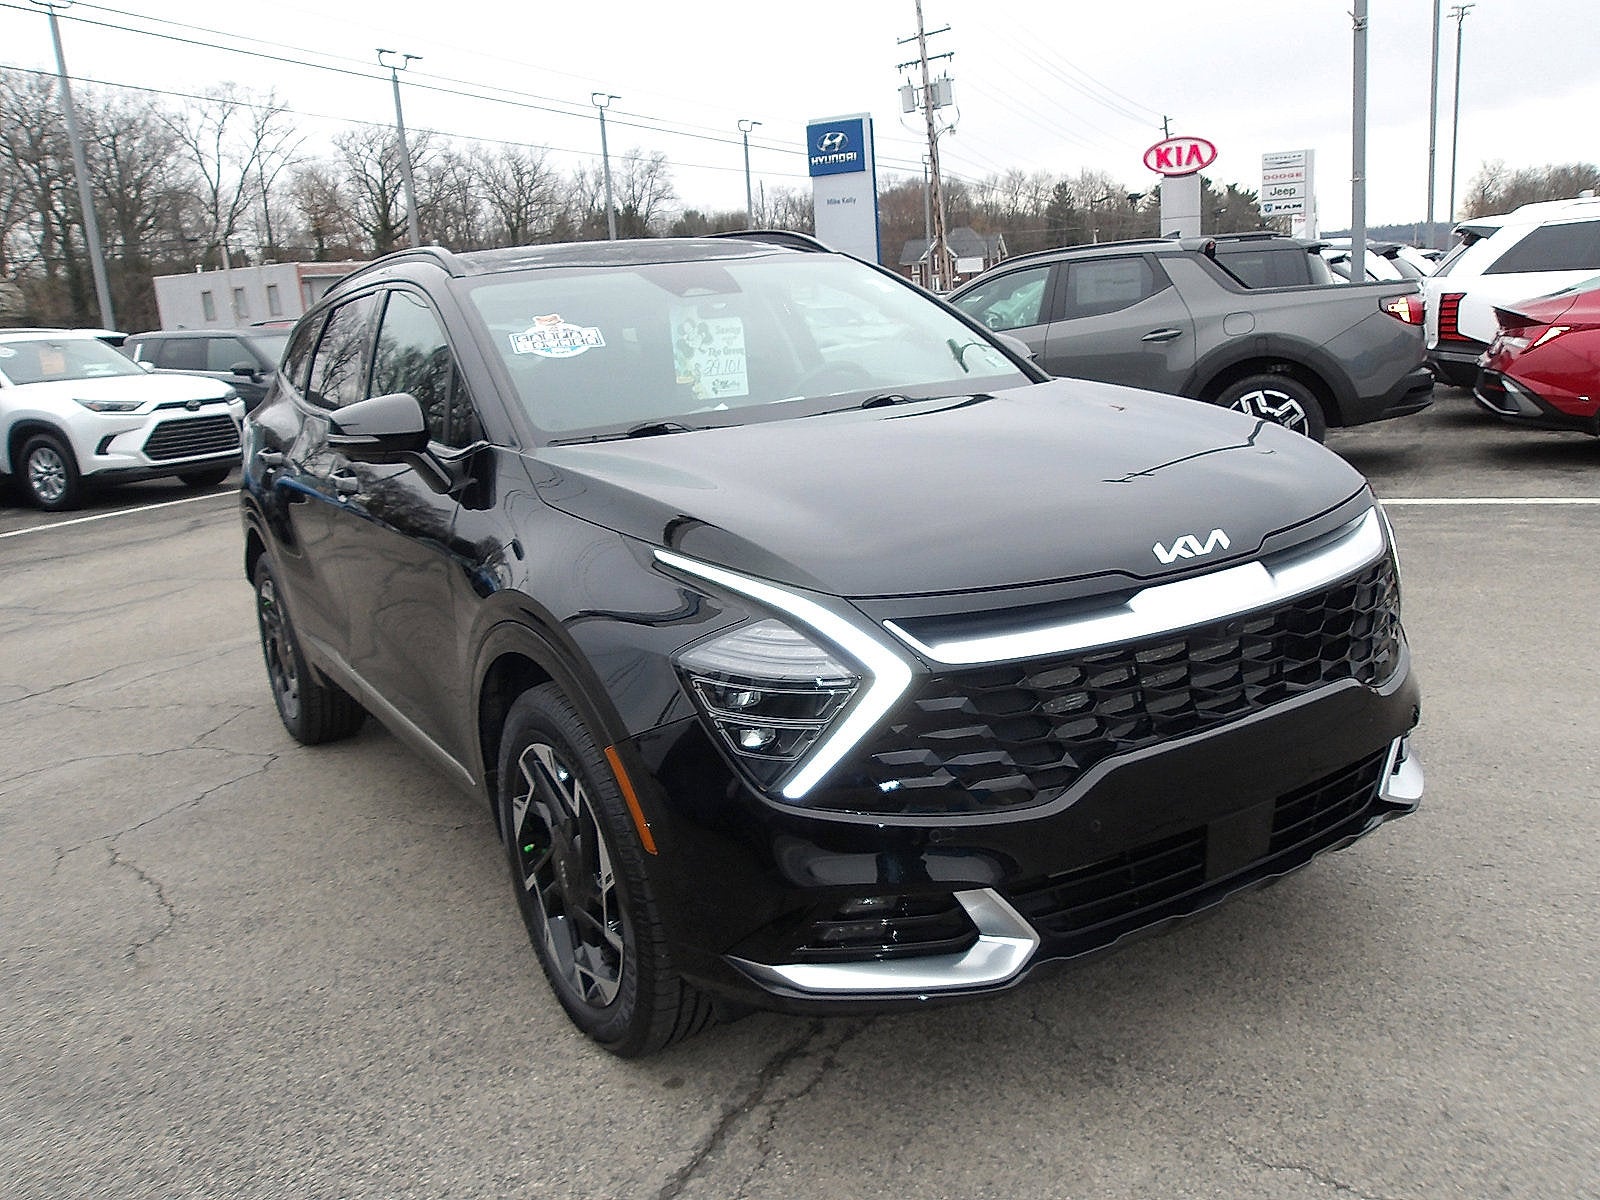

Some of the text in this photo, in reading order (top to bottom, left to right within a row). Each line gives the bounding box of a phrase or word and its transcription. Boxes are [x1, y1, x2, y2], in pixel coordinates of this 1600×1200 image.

[811, 151, 857, 166] HYUNDAI
[1155, 144, 1204, 169] KIA
[1264, 172, 1302, 180] DODGE
[1270, 187, 1296, 196] Jeep
[1152, 528, 1231, 565] KIA
